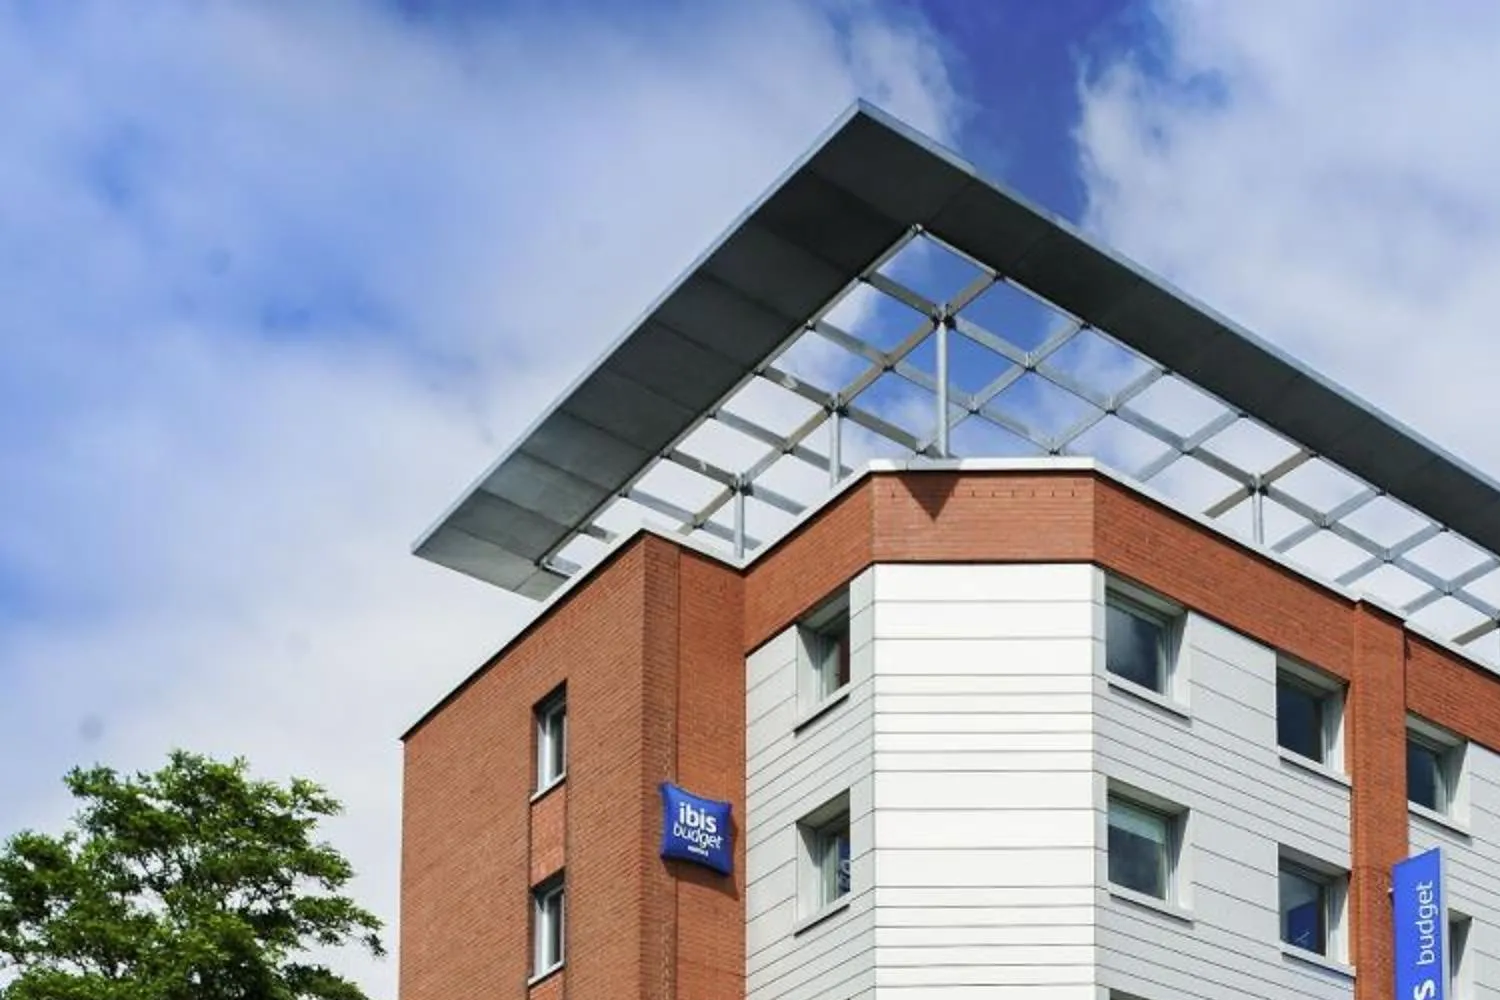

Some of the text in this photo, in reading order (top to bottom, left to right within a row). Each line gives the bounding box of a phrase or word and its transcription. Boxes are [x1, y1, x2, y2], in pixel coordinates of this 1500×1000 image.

[679, 801, 717, 834] ibis
[673, 821, 724, 850] budget
[1416, 880, 1439, 966] budget
